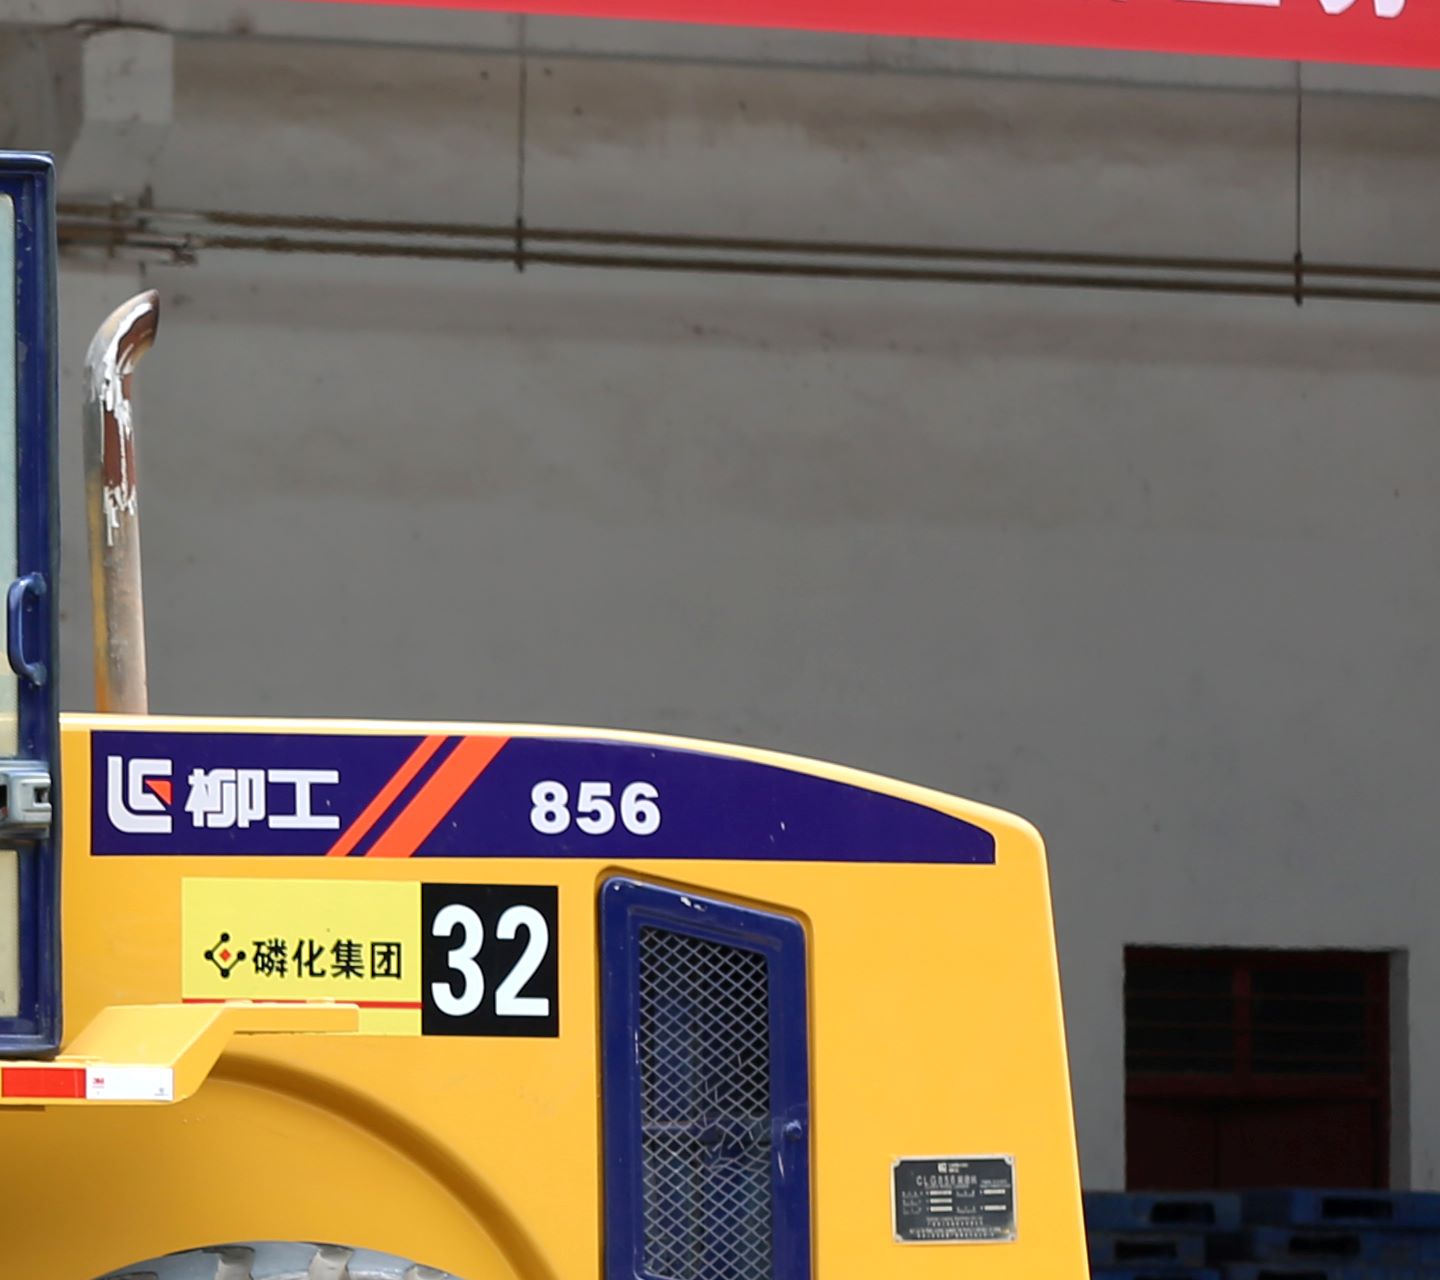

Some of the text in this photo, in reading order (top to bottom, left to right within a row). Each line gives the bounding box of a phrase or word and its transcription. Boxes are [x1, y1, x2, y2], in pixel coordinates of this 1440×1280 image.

[185, 768, 660, 835] 柳工 856
[251, 938, 403, 980] 磷化集团
[430, 903, 550, 1017] 32
